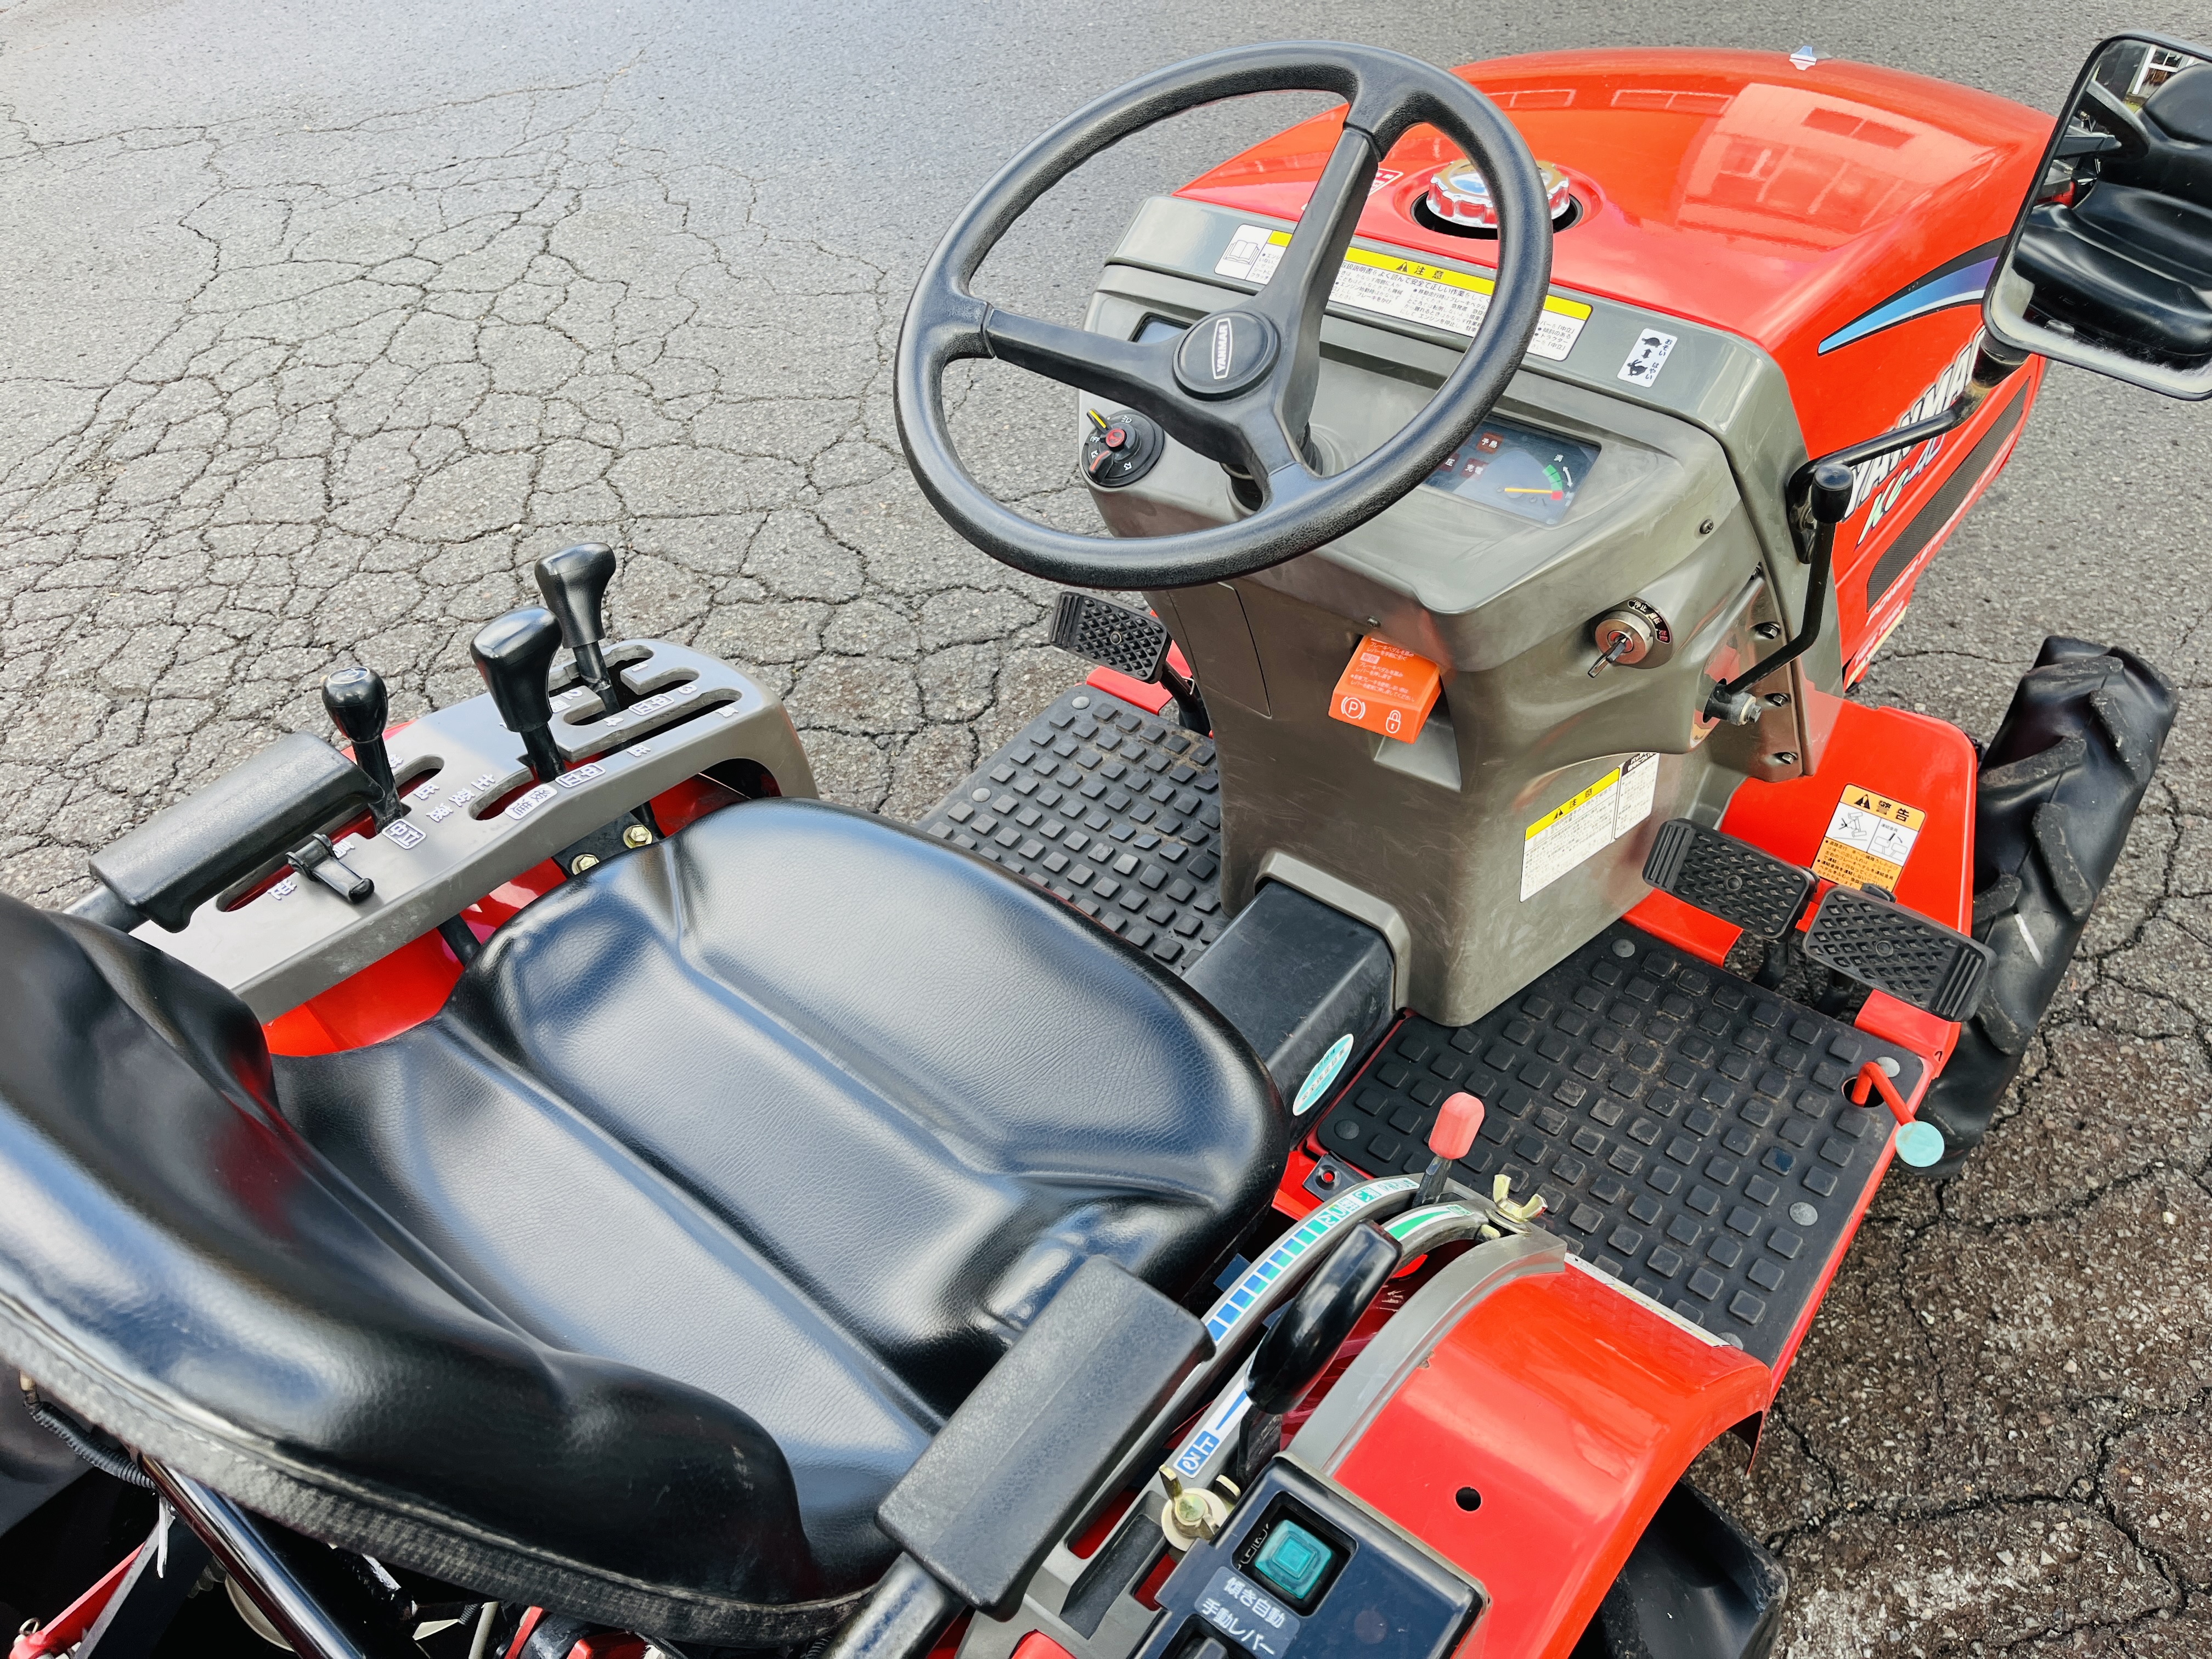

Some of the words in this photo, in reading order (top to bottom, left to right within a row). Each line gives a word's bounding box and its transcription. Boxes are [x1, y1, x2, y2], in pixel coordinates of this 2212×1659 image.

[1414, 264, 1445, 280] 注意
[1216, 324, 1228, 373] YANMAR
[1658, 338, 1672, 357] おそい
[1645, 362, 1660, 380] はやい
[1843, 325, 1986, 523] YANMA
[1444, 458, 1455, 467] 圧
[678, 684, 697, 695] 3
[632, 696, 668, 713] 中立
[560, 766, 600, 786] 中立
[413, 781, 440, 800] 低
[510, 788, 551, 816] 後進
[390, 822, 420, 847] 中立
[1223, 1577, 1285, 1629] 傾き自動
[1201, 1598, 1275, 1655] 手動レバー
